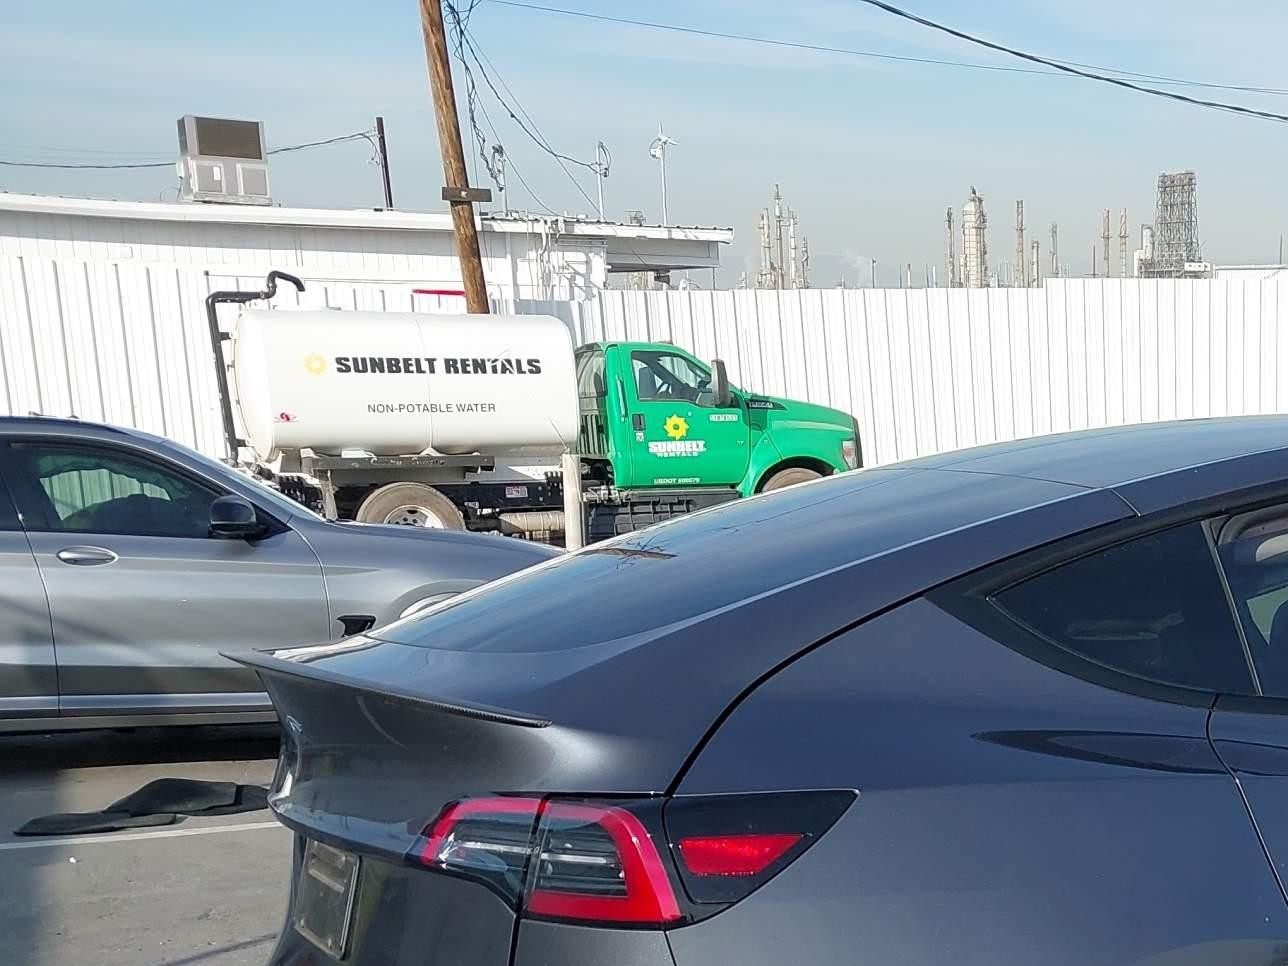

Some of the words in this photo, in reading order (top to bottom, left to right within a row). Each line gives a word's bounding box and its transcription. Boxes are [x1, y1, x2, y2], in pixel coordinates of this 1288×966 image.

[335, 357, 437, 374] SUNBELT
[444, 357, 542, 375] RENTALS
[367, 403, 453, 414] NON-POTABLE
[456, 403, 496, 413] WATER
[648, 440, 706, 453] SUNBELT
